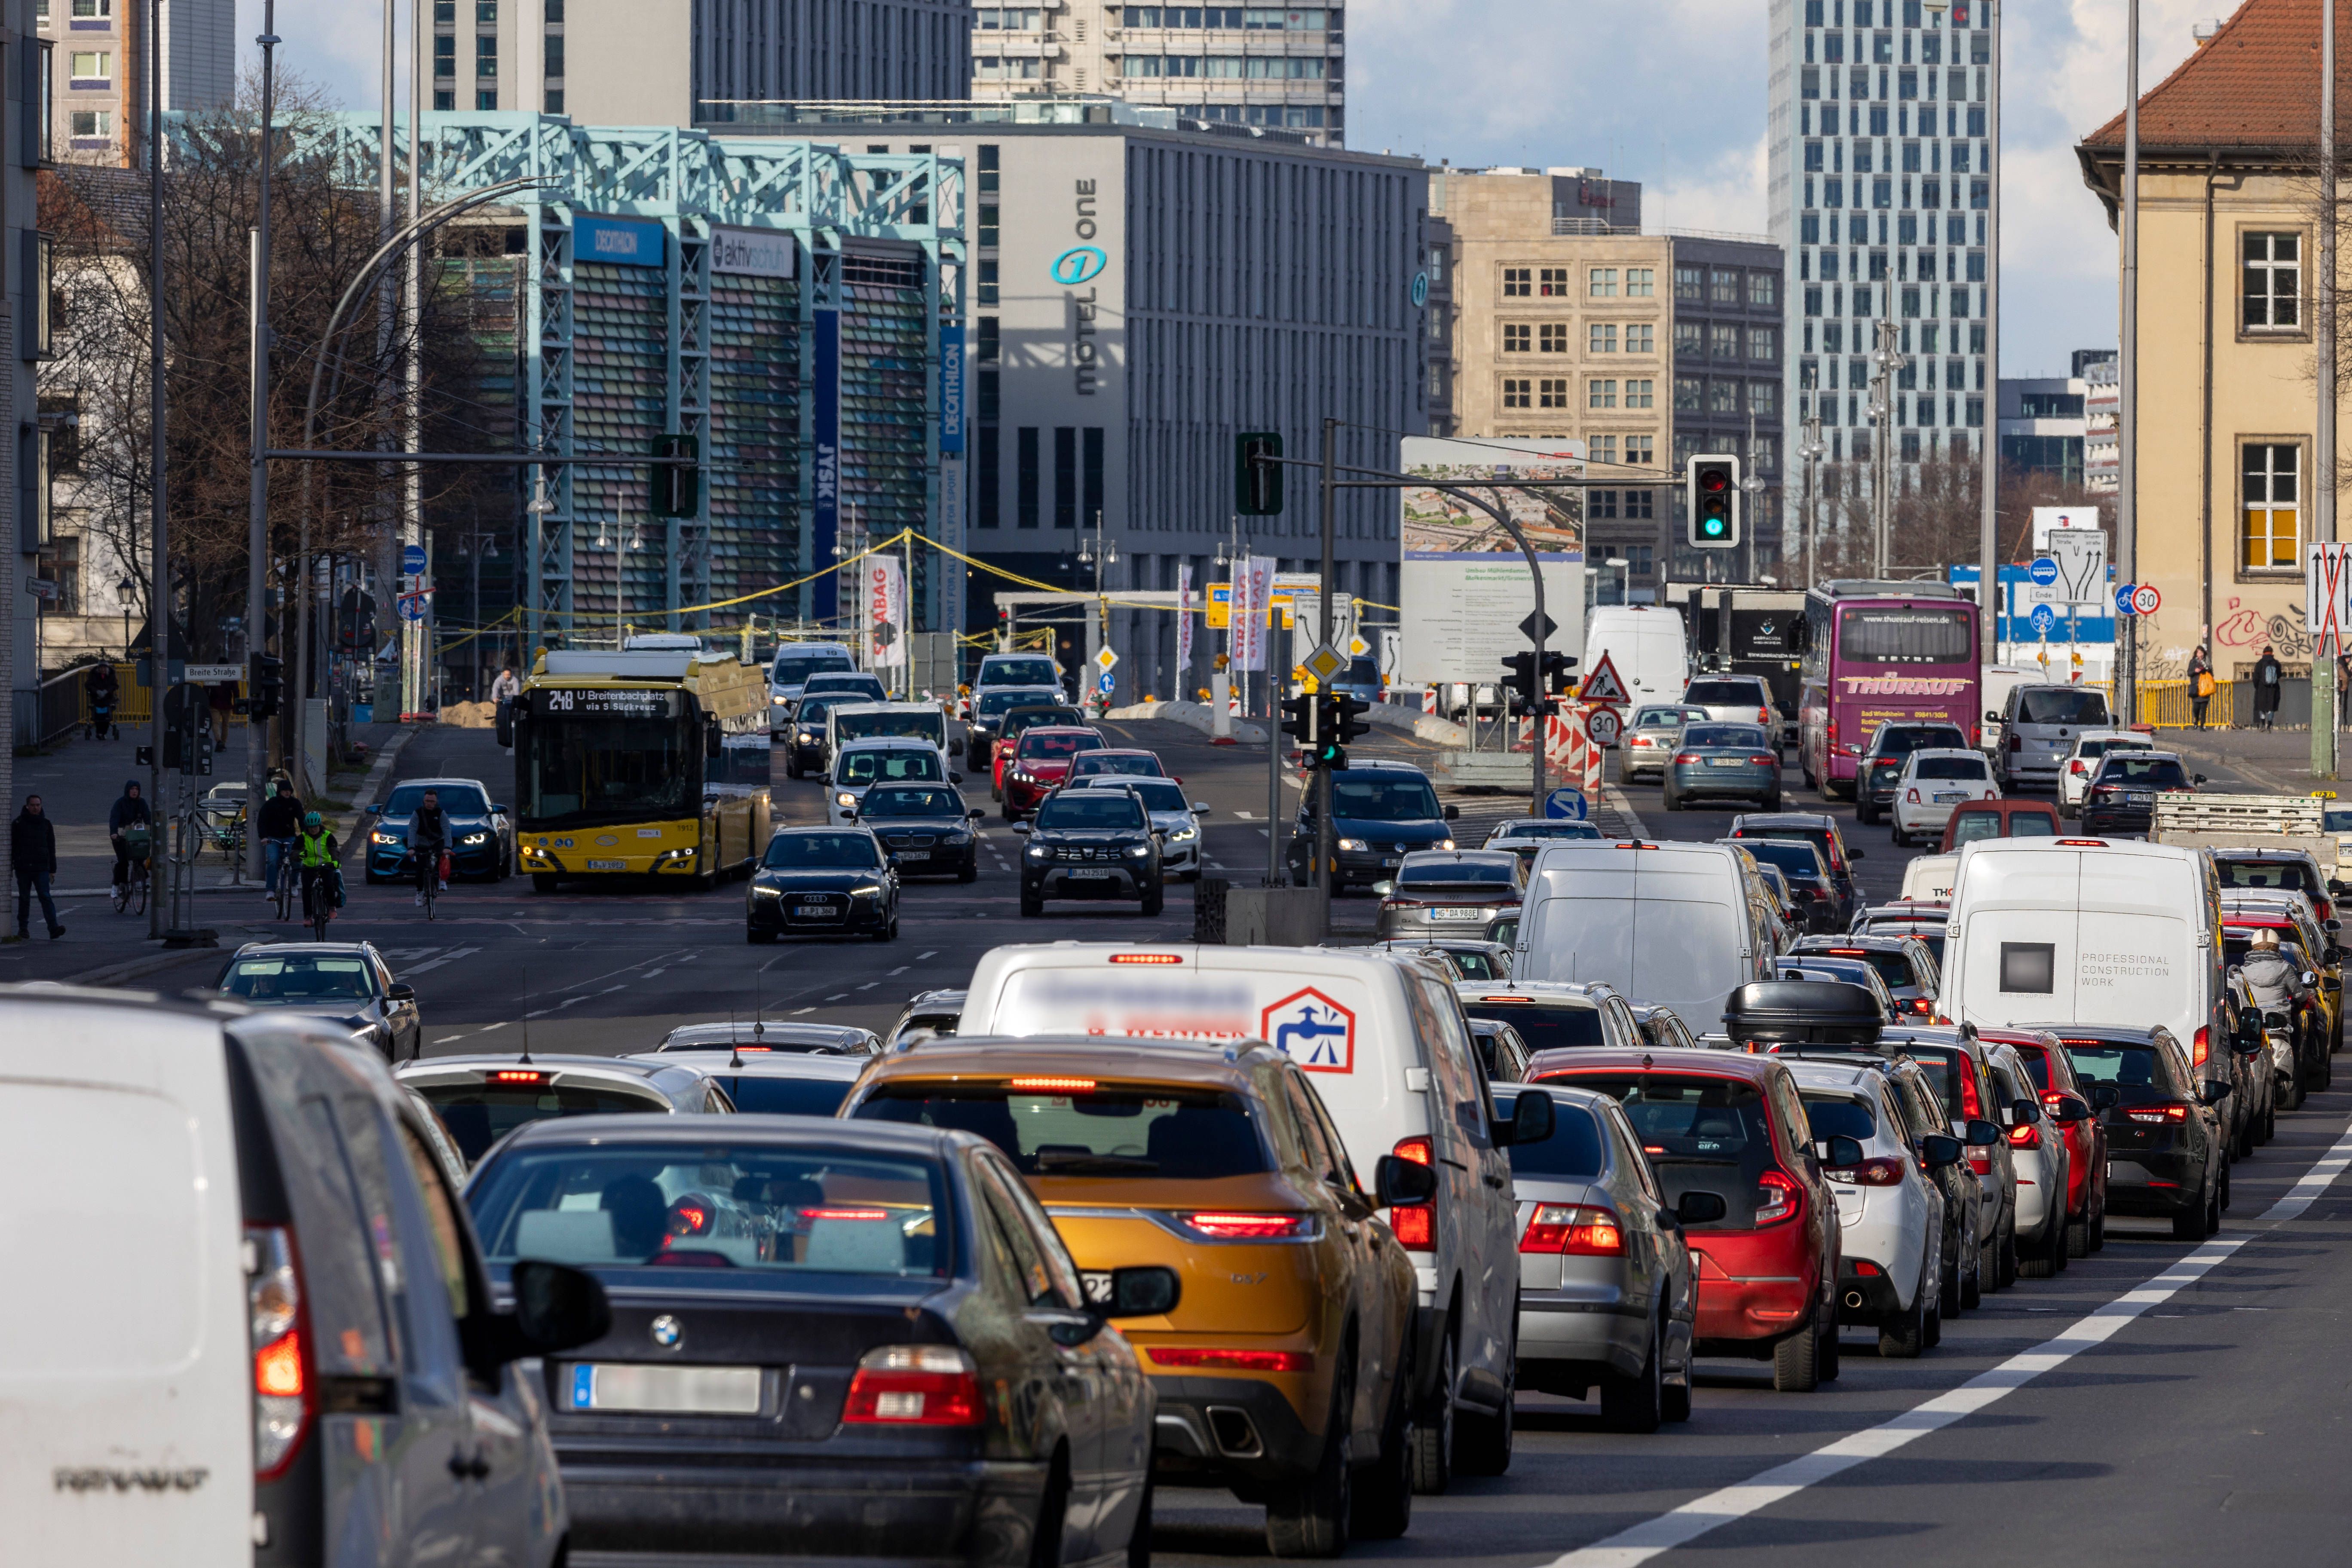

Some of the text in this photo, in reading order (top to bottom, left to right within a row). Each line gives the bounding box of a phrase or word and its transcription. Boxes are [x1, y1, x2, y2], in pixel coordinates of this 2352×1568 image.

[595, 229, 637, 254] DECATHLON
[1075, 178, 1097, 396] MOTEL ONE
[945, 343, 960, 435] DECATHLON
[818, 443, 836, 499] JYSK
[947, 469, 957, 502] SPORT
[2139, 593, 2155, 607] 30
[873, 568, 888, 655] SABAG
[1863, 616, 1950, 624] www.thuerauf-reisen.de
[213, 668, 236, 677] Straße
[1845, 671, 1966, 695] THÜRAUF
[549, 690, 665, 710] 248 U Breitenbachplatz
[613, 702, 656, 710] Südkreuz
[1592, 716, 1614, 733] 30
[2082, 953, 2170, 965] PROFESSIONAL
[2082, 965, 2169, 977] CONSTRUCTION
[2081, 977, 2115, 987] WORK
